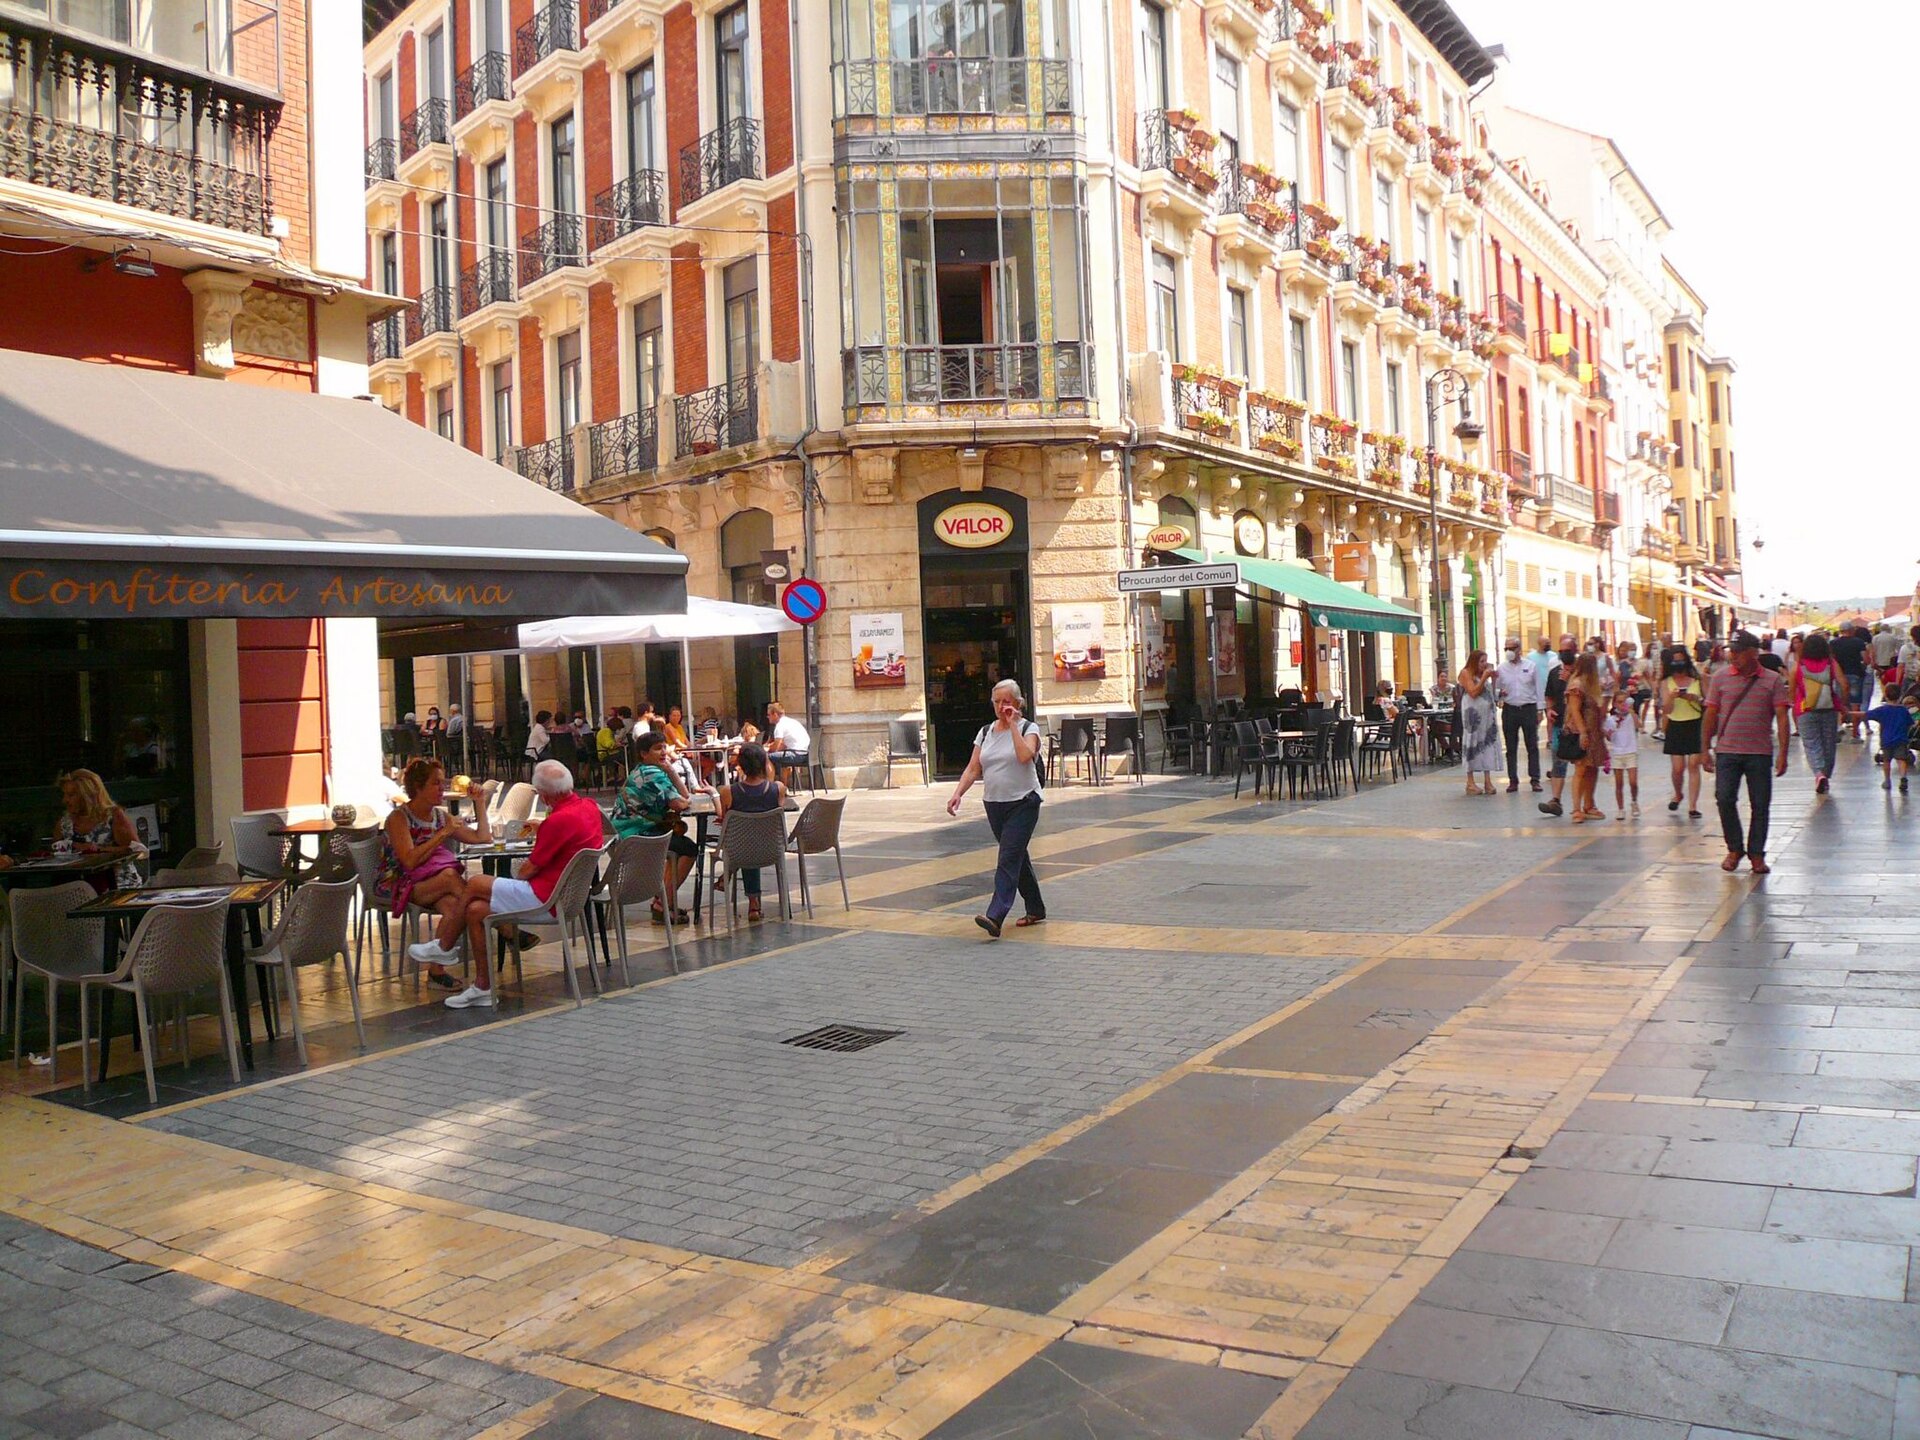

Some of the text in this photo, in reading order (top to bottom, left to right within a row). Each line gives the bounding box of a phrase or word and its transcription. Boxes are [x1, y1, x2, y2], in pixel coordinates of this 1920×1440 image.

[942, 517, 1004, 535] VALOR
[1151, 532, 1183, 544] VALOR
[1178, 572, 1194, 582] del
[1196, 570, 1232, 581] Común
[9, 567, 513, 613] Confitería Artesana
